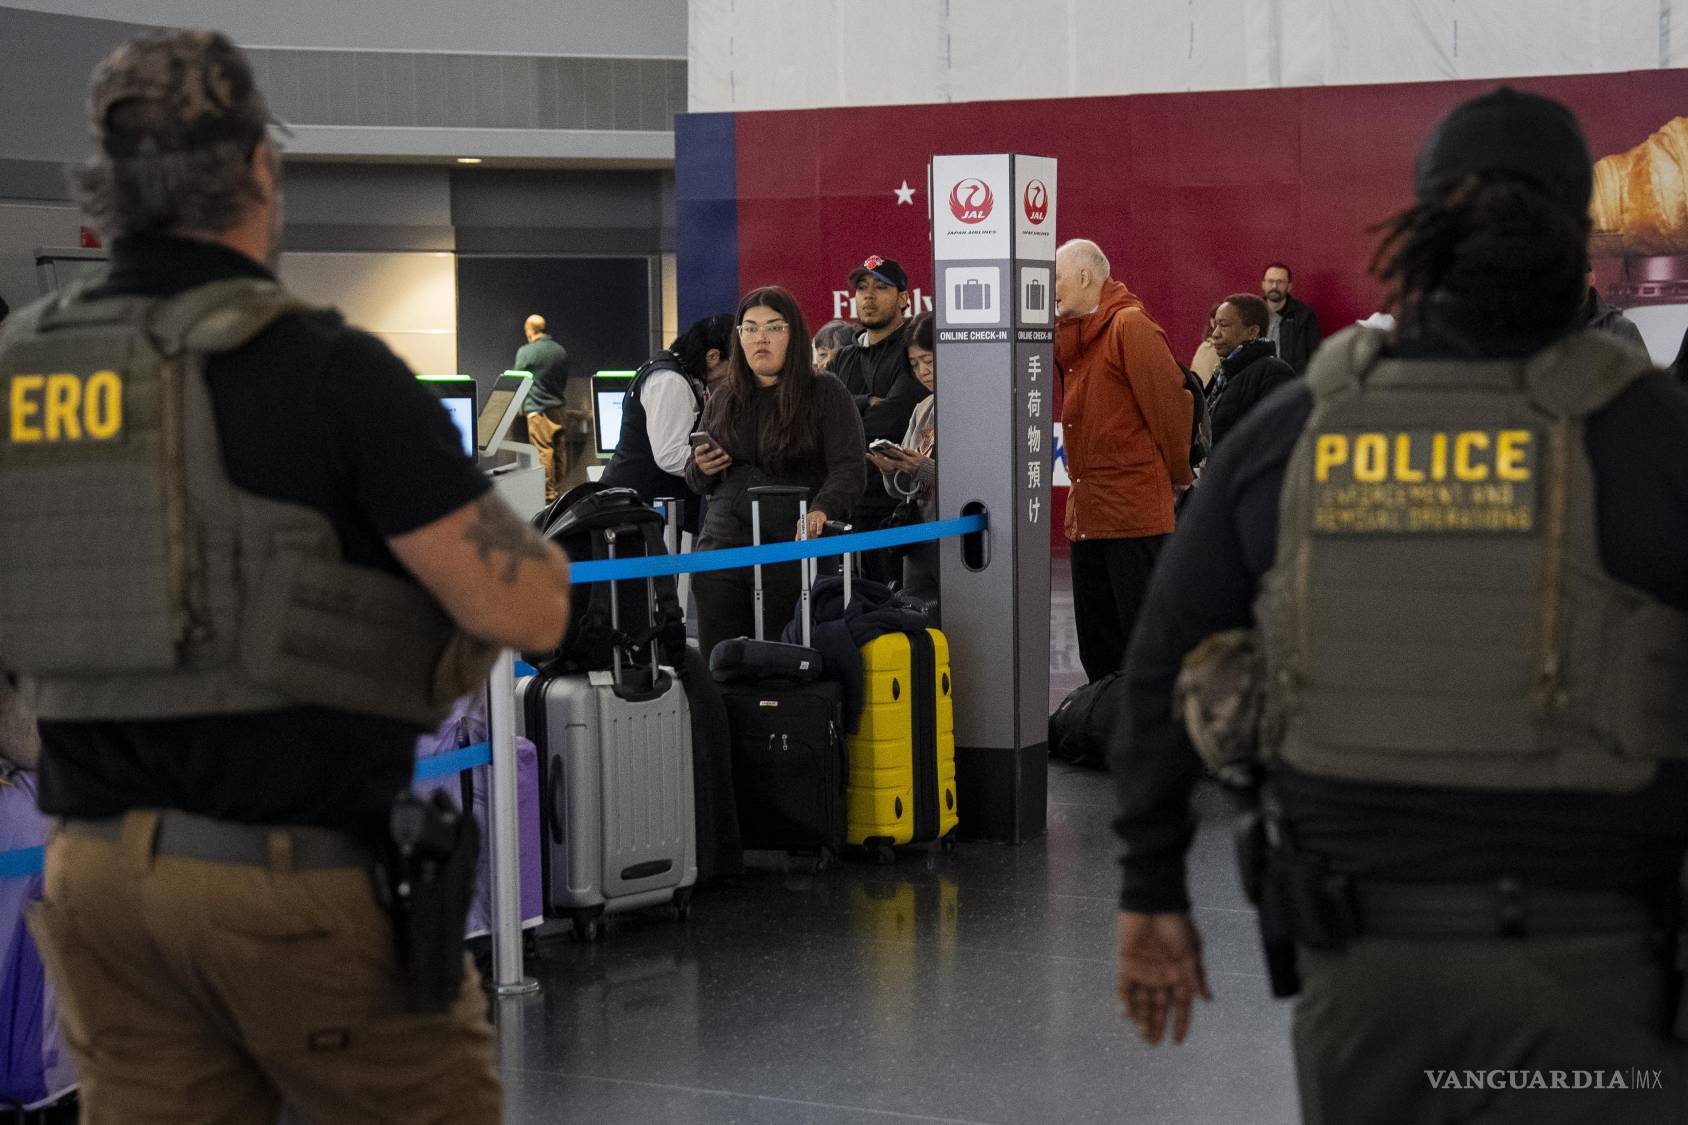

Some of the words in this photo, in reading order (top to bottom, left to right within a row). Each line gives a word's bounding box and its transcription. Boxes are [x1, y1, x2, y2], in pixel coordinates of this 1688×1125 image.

[961, 211, 985, 219] JAL
[1030, 211, 1044, 220] JAL
[940, 331, 969, 341] ONLINE
[970, 330, 1007, 340] CHECK-IN
[10, 369, 122, 442] ERO
[1027, 355, 1042, 523] 手荷物預け
[1315, 430, 1531, 482] POLICE
